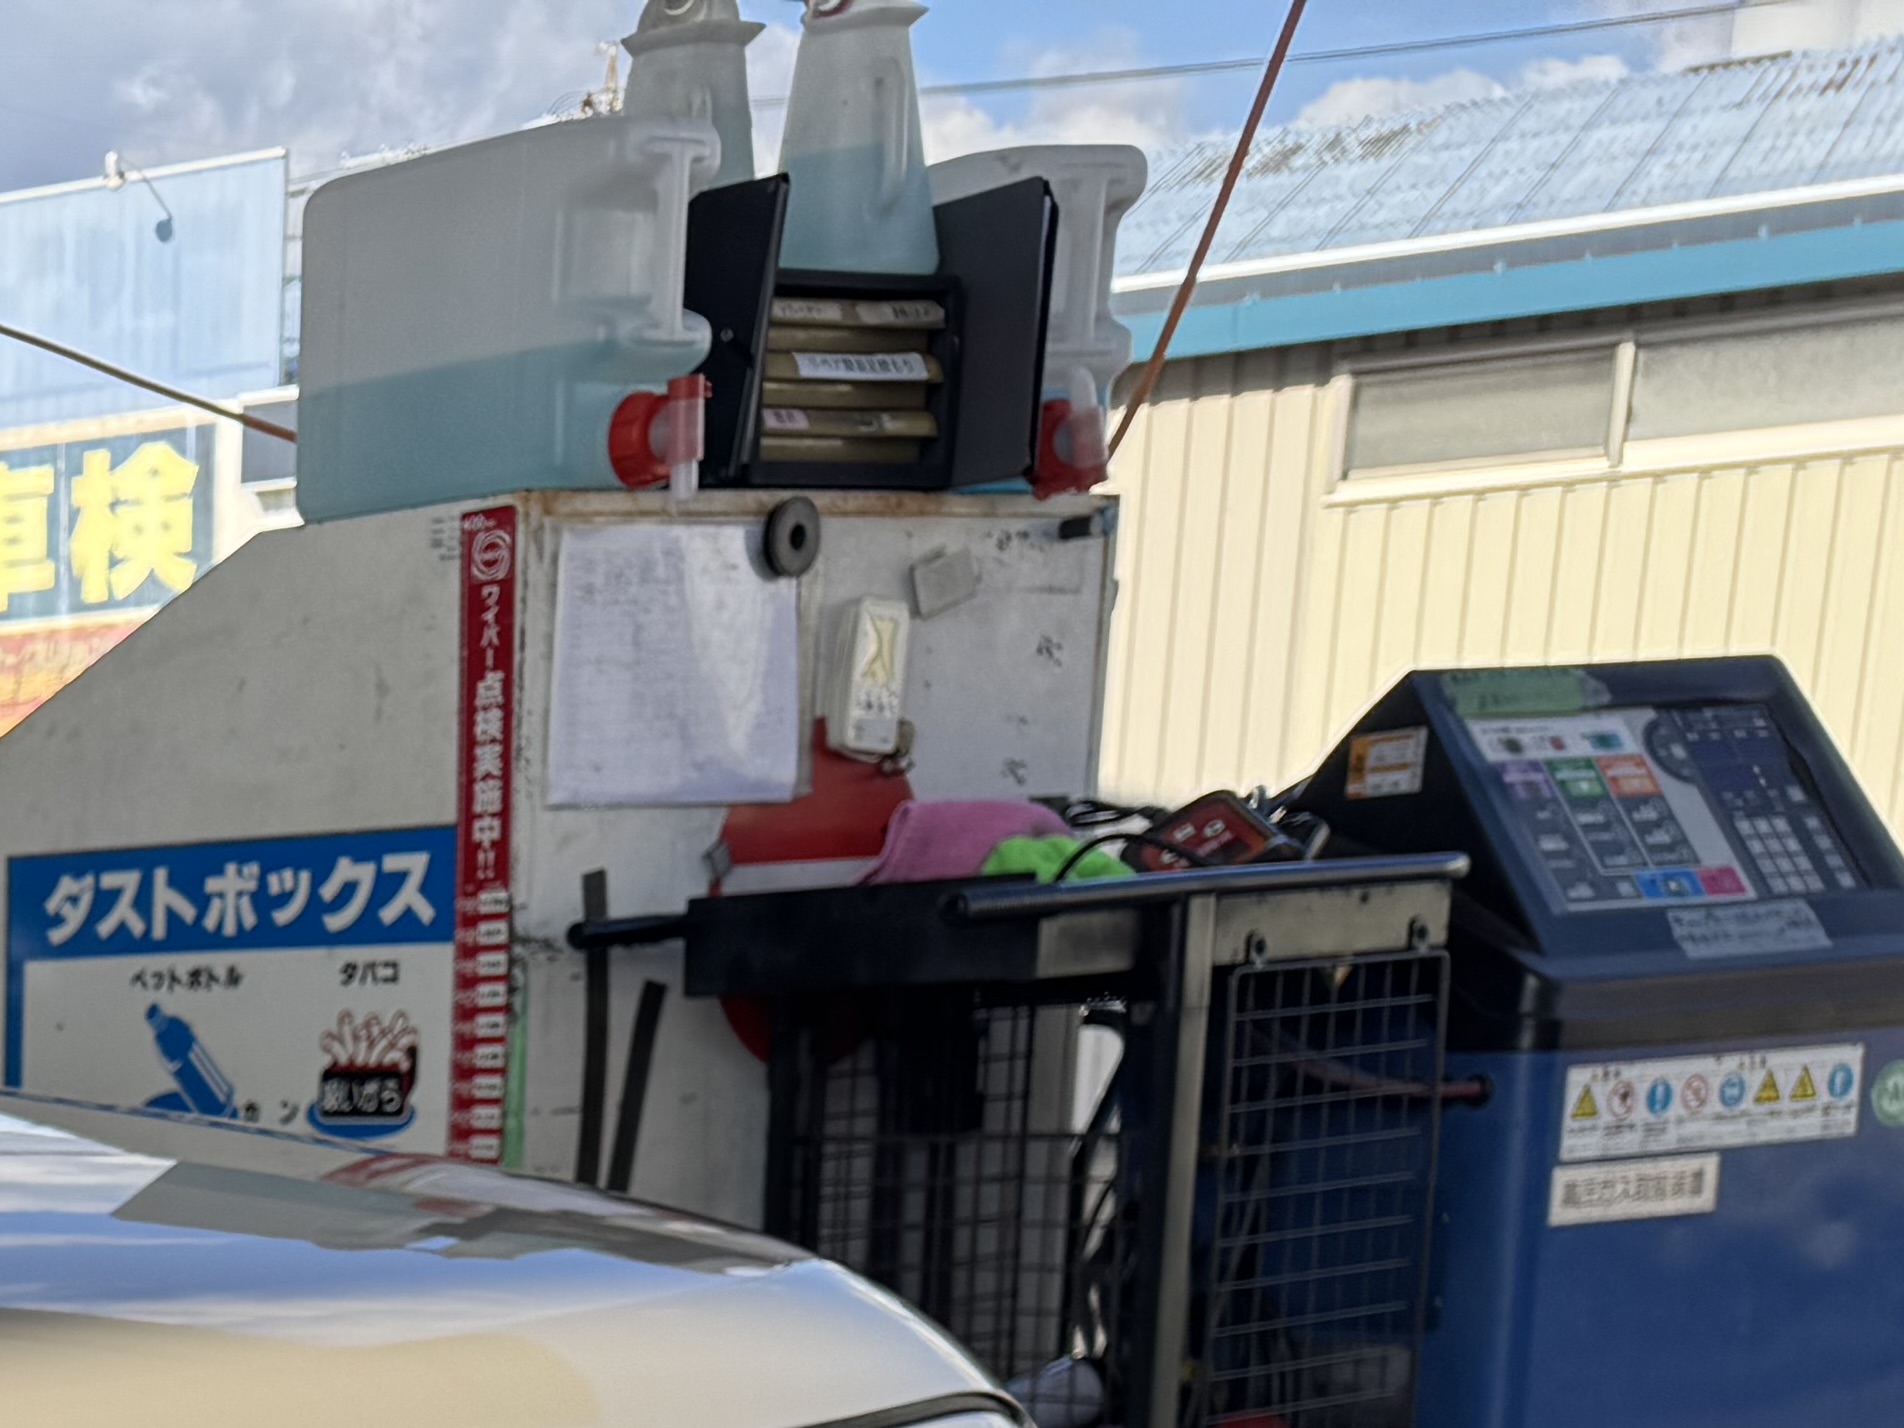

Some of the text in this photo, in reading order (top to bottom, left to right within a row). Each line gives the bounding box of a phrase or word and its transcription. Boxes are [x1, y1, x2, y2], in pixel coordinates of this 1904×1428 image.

[43, 852, 437, 946] ダストボックス
[130, 964, 243, 992] ペットボトル
[340, 960, 400, 987] タバコ
